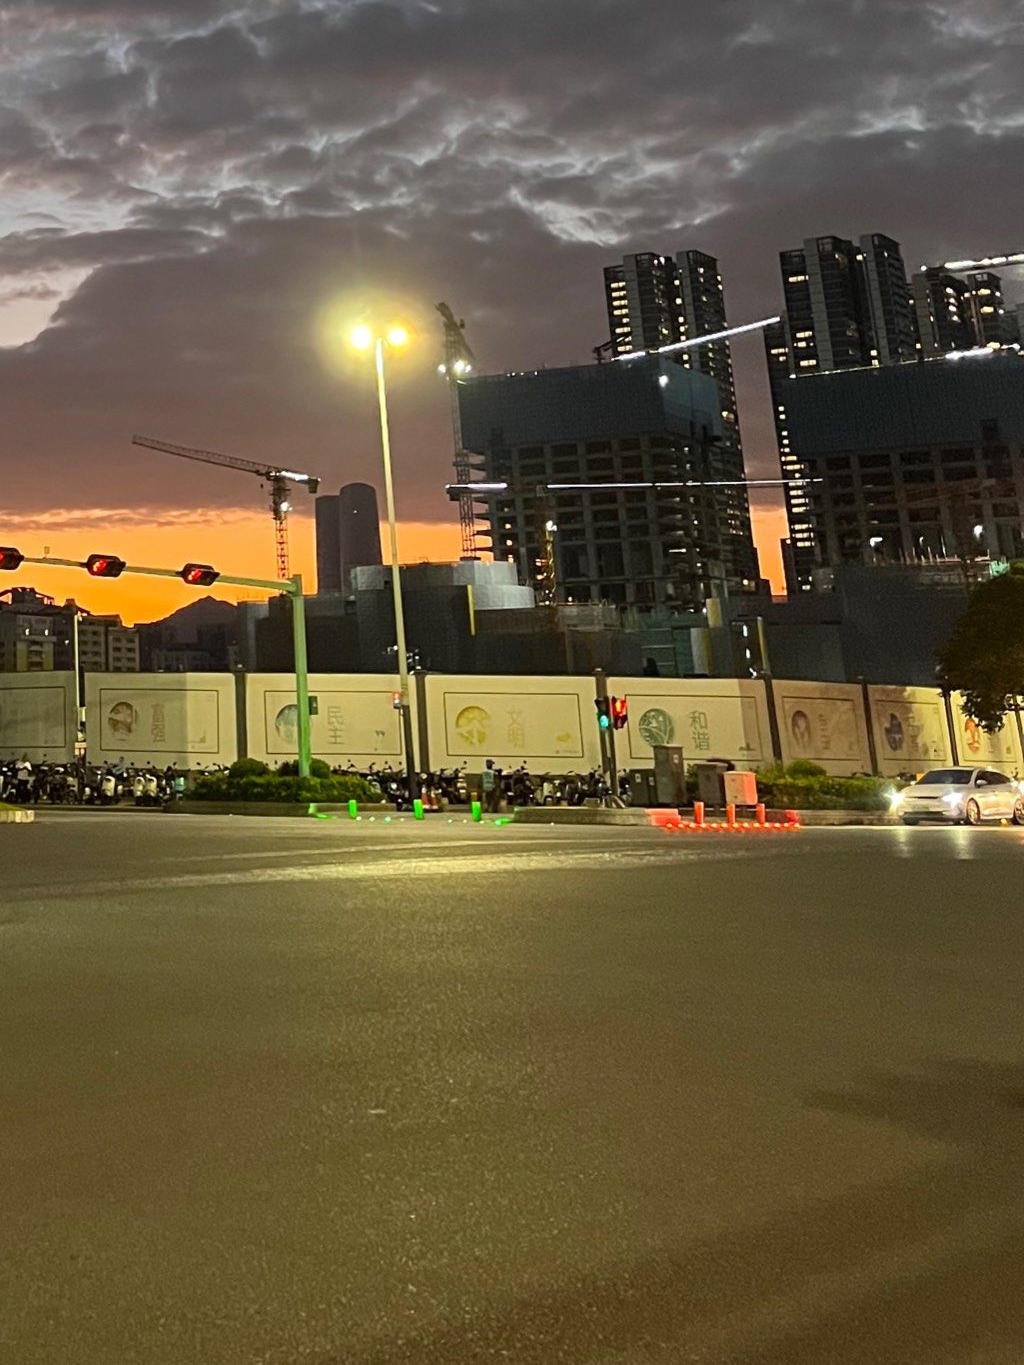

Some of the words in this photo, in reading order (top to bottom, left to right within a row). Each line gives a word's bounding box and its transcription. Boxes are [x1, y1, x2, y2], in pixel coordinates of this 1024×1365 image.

[328, 706, 345, 745] 民主
[505, 705, 525, 748] 文明
[689, 710, 710, 750] 和谐
